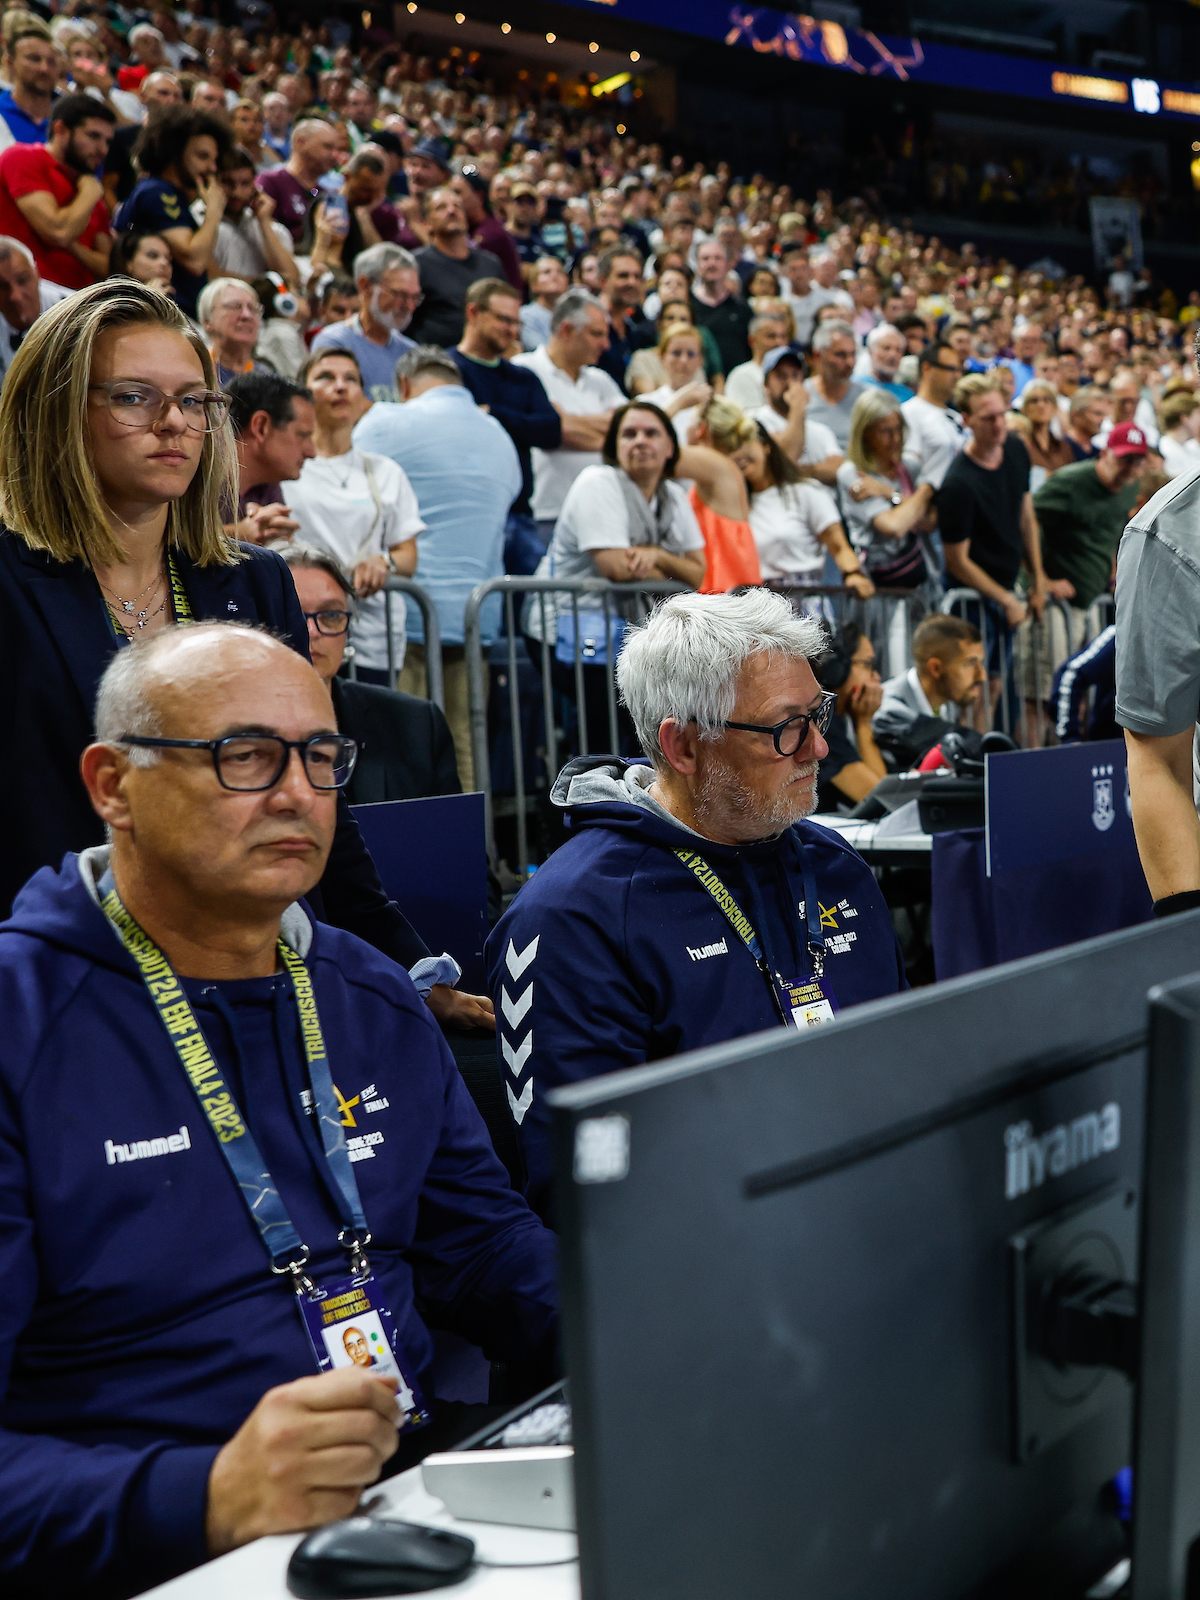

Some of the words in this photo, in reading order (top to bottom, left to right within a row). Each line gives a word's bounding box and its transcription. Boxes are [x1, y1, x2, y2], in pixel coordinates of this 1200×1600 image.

[687, 856, 756, 945] TRUCKSCOUT24
[101, 889, 184, 1005] TRUCKSCOUT24
[685, 937, 729, 961] hummel
[161, 1000, 199, 1037] EHF
[174, 1032, 225, 1096] FINAL4
[103, 1125, 192, 1165] hummel
[203, 1092, 246, 1144] 2023
[1003, 1101, 1120, 1200] iiyama
